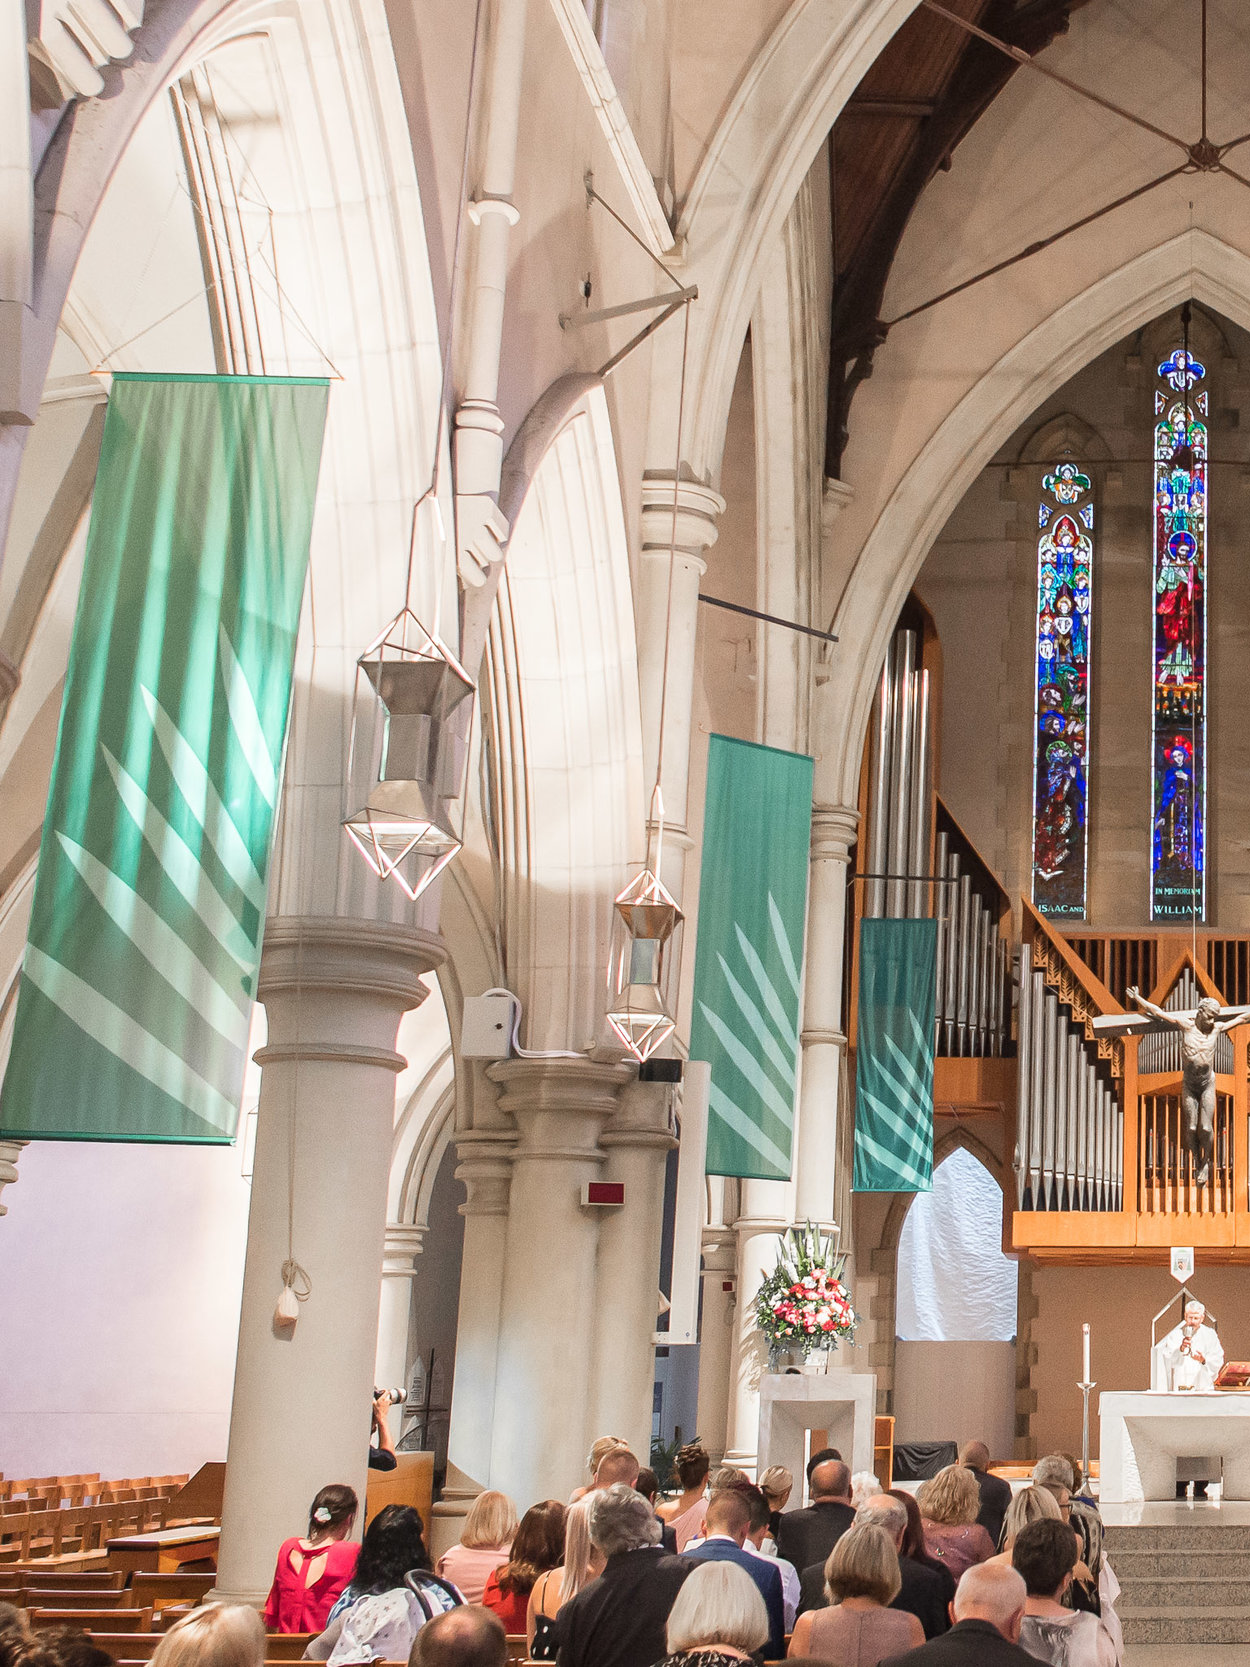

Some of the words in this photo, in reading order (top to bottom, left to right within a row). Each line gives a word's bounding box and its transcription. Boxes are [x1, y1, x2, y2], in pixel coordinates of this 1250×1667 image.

[1155, 887, 1163, 895] IN
[1164, 887, 1201, 895] MEMORIAM
[1038, 904, 1068, 913] ISAAC
[1154, 905, 1202, 914] WILLIAM
